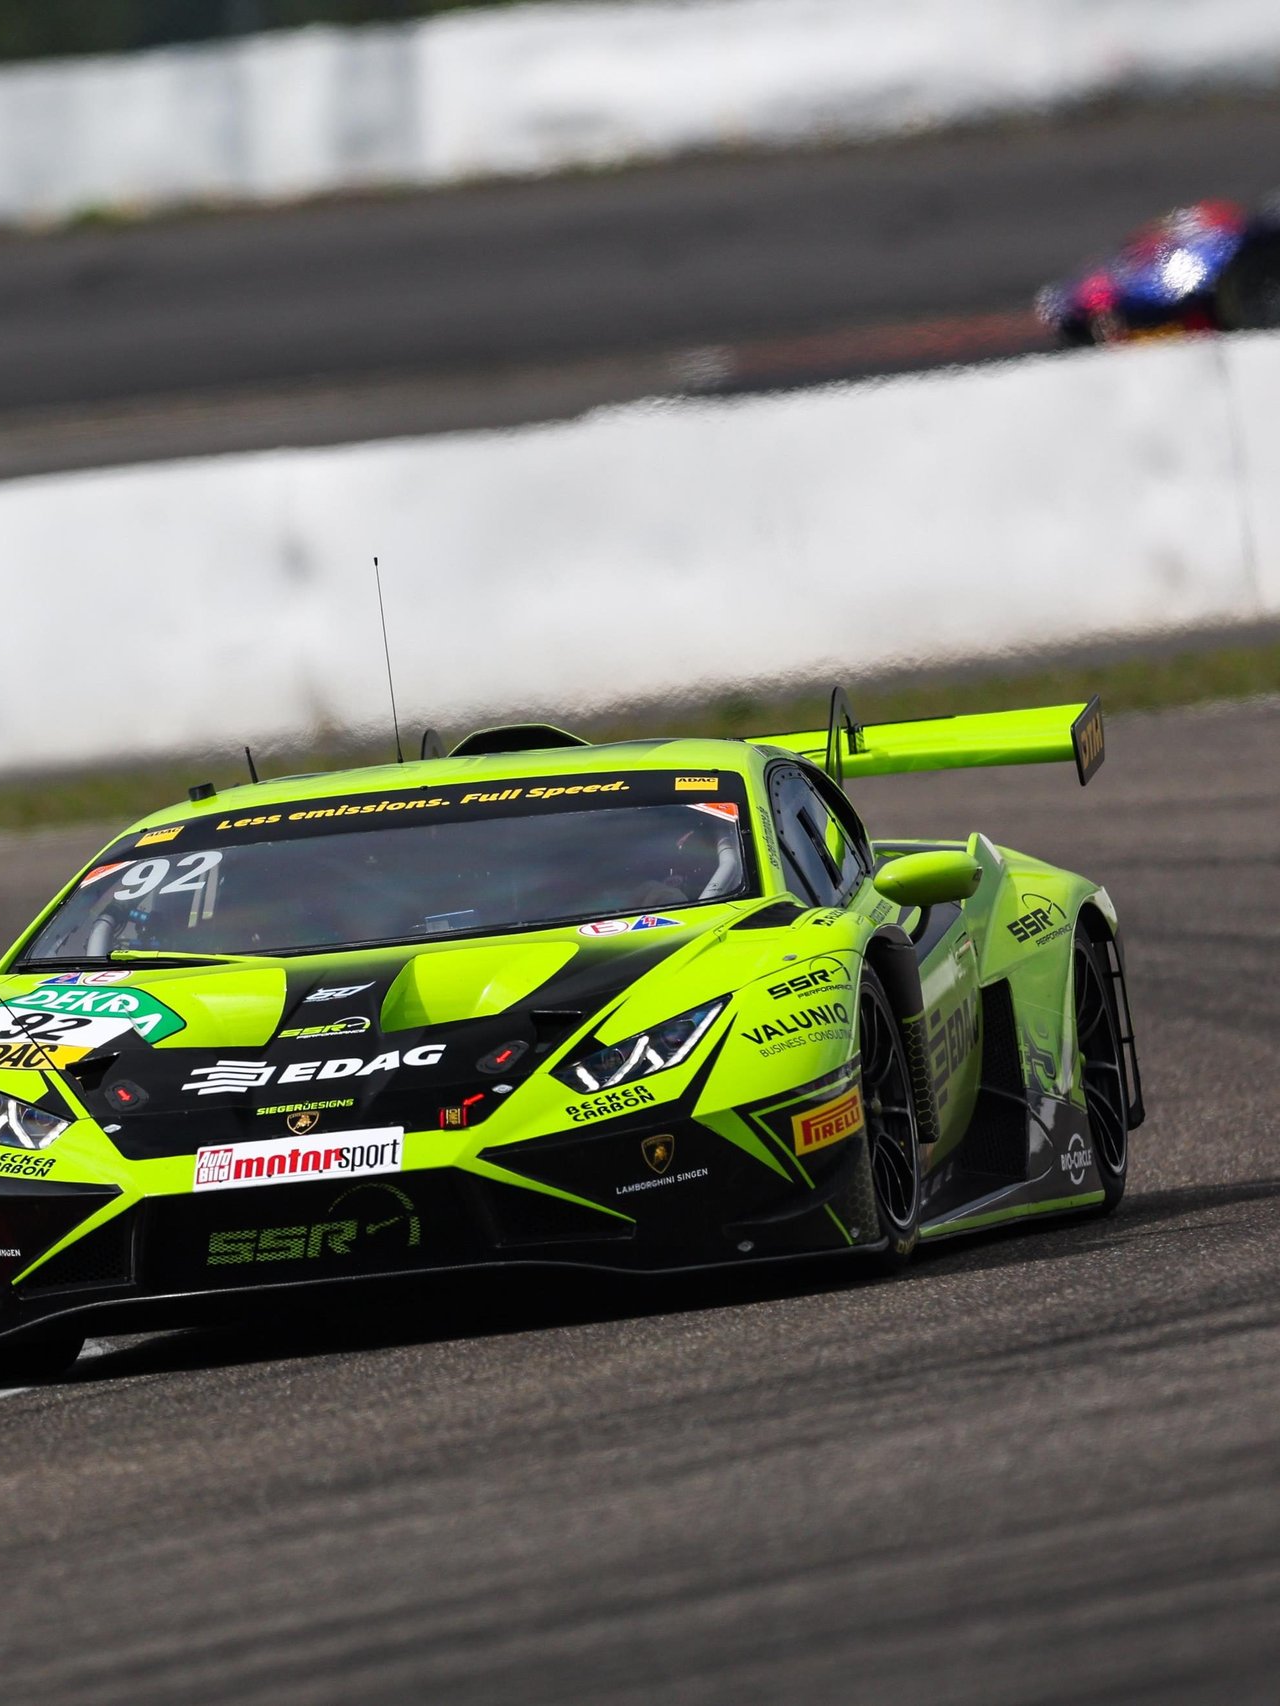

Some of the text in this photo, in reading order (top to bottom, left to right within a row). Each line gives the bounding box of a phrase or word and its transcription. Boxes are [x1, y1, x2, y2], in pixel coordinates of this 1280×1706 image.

[216, 780, 631, 831] Less emissions. Full Speed.
[113, 851, 223, 900] 92
[1007, 907, 1054, 944] SSR
[767, 969, 833, 1000] SSR
[11, 990, 163, 1038] DEKRA
[278, 1023, 348, 1038] SSR
[741, 1003, 849, 1045] VALUNIQ
[760, 1036, 807, 1058] BUSINESS
[277, 1045, 447, 1084] EDAG
[566, 1085, 648, 1116] BECKER
[572, 1093, 655, 1122] CARBON
[801, 1095, 860, 1146] PIRELLI
[197, 1164, 229, 1184] Bild
[199, 1149, 232, 1168] Auto
[615, 1168, 708, 1195] LAMBORGHINI SINGEN
[207, 1220, 359, 1266] SSR
